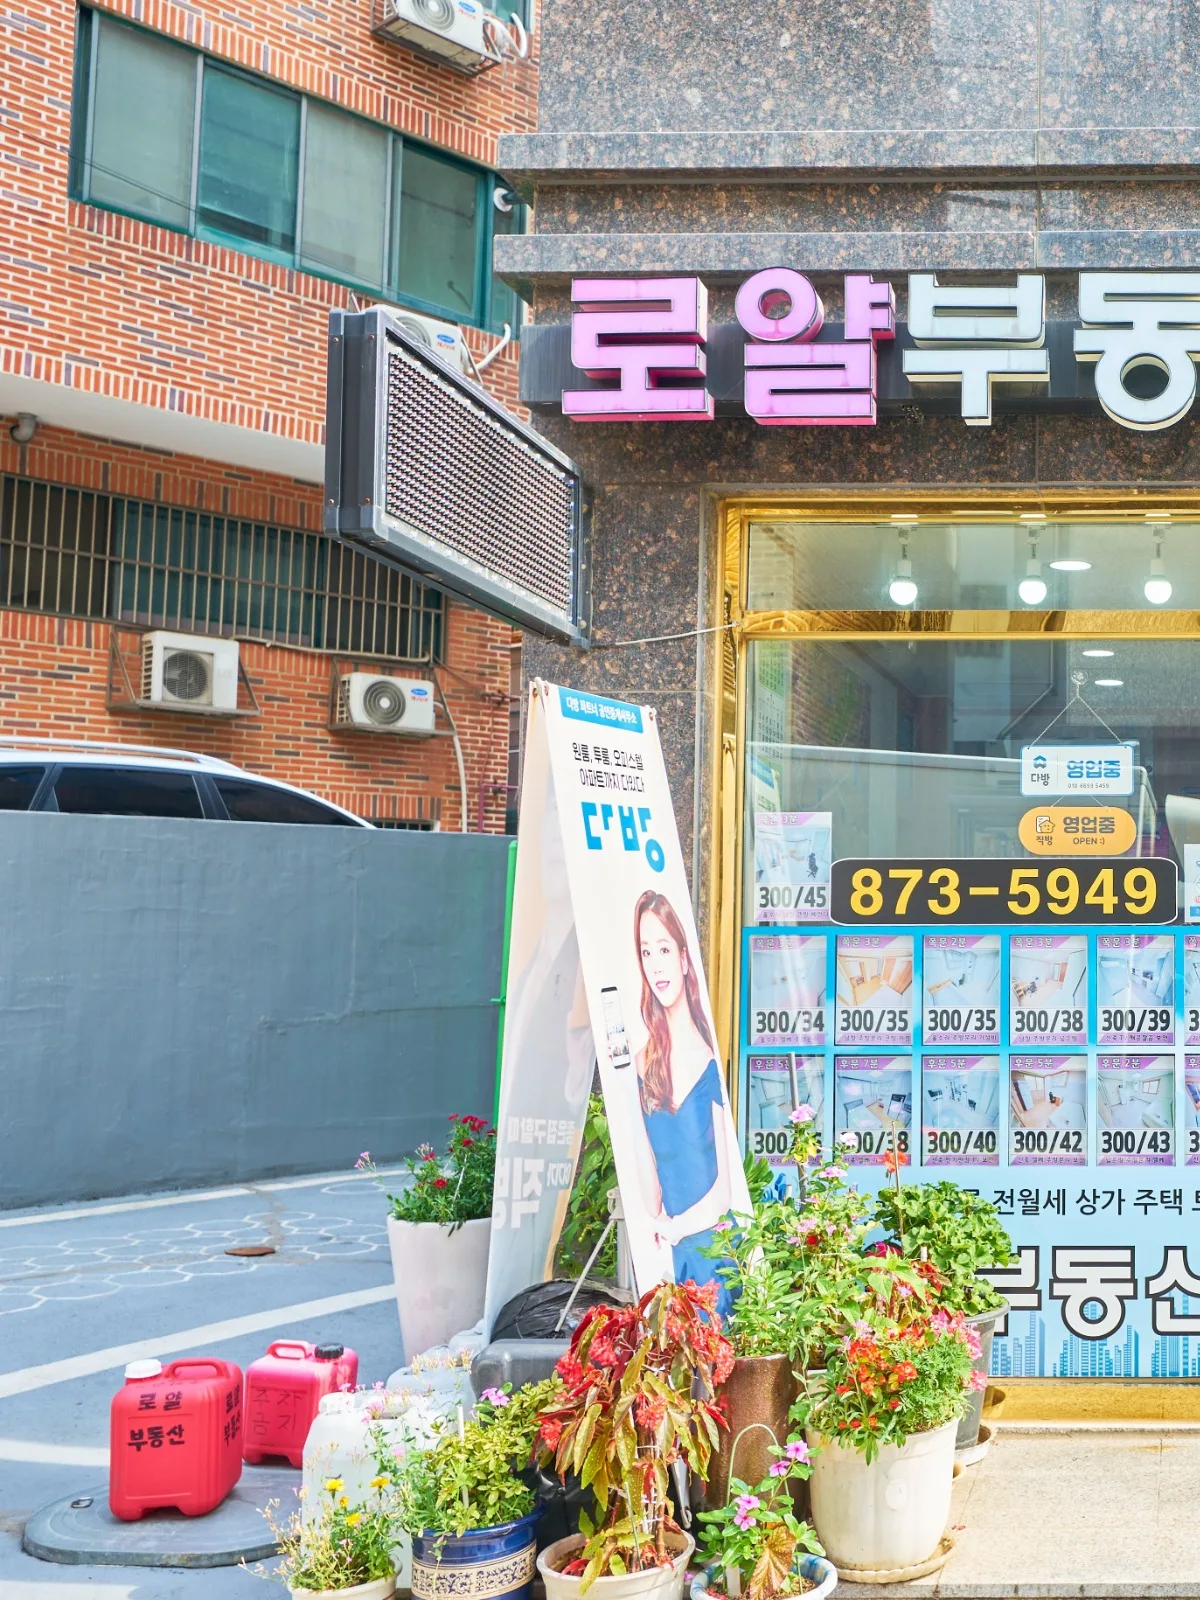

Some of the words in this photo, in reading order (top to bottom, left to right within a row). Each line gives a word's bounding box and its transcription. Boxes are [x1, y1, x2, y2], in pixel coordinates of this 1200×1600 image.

[613, 749, 644, 771] 오피스텔
[1066, 760, 1121, 779] 영업중
[1030, 773, 1051, 786] 다방
[1063, 816, 1116, 834] 영업중
[580, 801, 666, 873] 다방
[1036, 836, 1053, 846] 직방
[1072, 837, 1097, 845] OPEN
[759, 886, 827, 908] 300/45
[850, 867, 1157, 916] 873-5949
[864, 937, 880, 947] 3분
[951, 937, 966, 948] 2분
[1037, 937, 1053, 948] 3분
[1125, 937, 1141, 948] 3분
[756, 1010, 825, 1033] 300/34
[840, 1009, 909, 1032] 300/35
[928, 1009, 997, 1032] 300/35
[1014, 1009, 1084, 1033] 300/38
[1101, 1009, 1171, 1033] 300/39
[755, 1060, 774, 1069] 후문
[840, 1059, 859, 1069] 후문
[863, 1059, 878, 1069] 7분
[928, 1059, 946, 1069] 후문
[950, 1059, 966, 1069] 5분
[1014, 1058, 1034, 1068] 후문
[1037, 1058, 1053, 1068] 5분
[1101, 1058, 1121, 1068] 후문
[1125, 1058, 1141, 1068] 2분
[840, 1131, 909, 1154] 00/38
[928, 1131, 996, 1154] 300/40
[1014, 1130, 1083, 1154] 300/42
[1101, 1130, 1170, 1154] 300/43
[993, 1188, 1067, 1216] 전월세
[1075, 1188, 1126, 1216] 상가
[1133, 1188, 1183, 1216] 주택
[252, 1389, 302, 1408] 주차
[252, 1412, 296, 1436] 금지
[127, 1424, 185, 1452] 부동산
